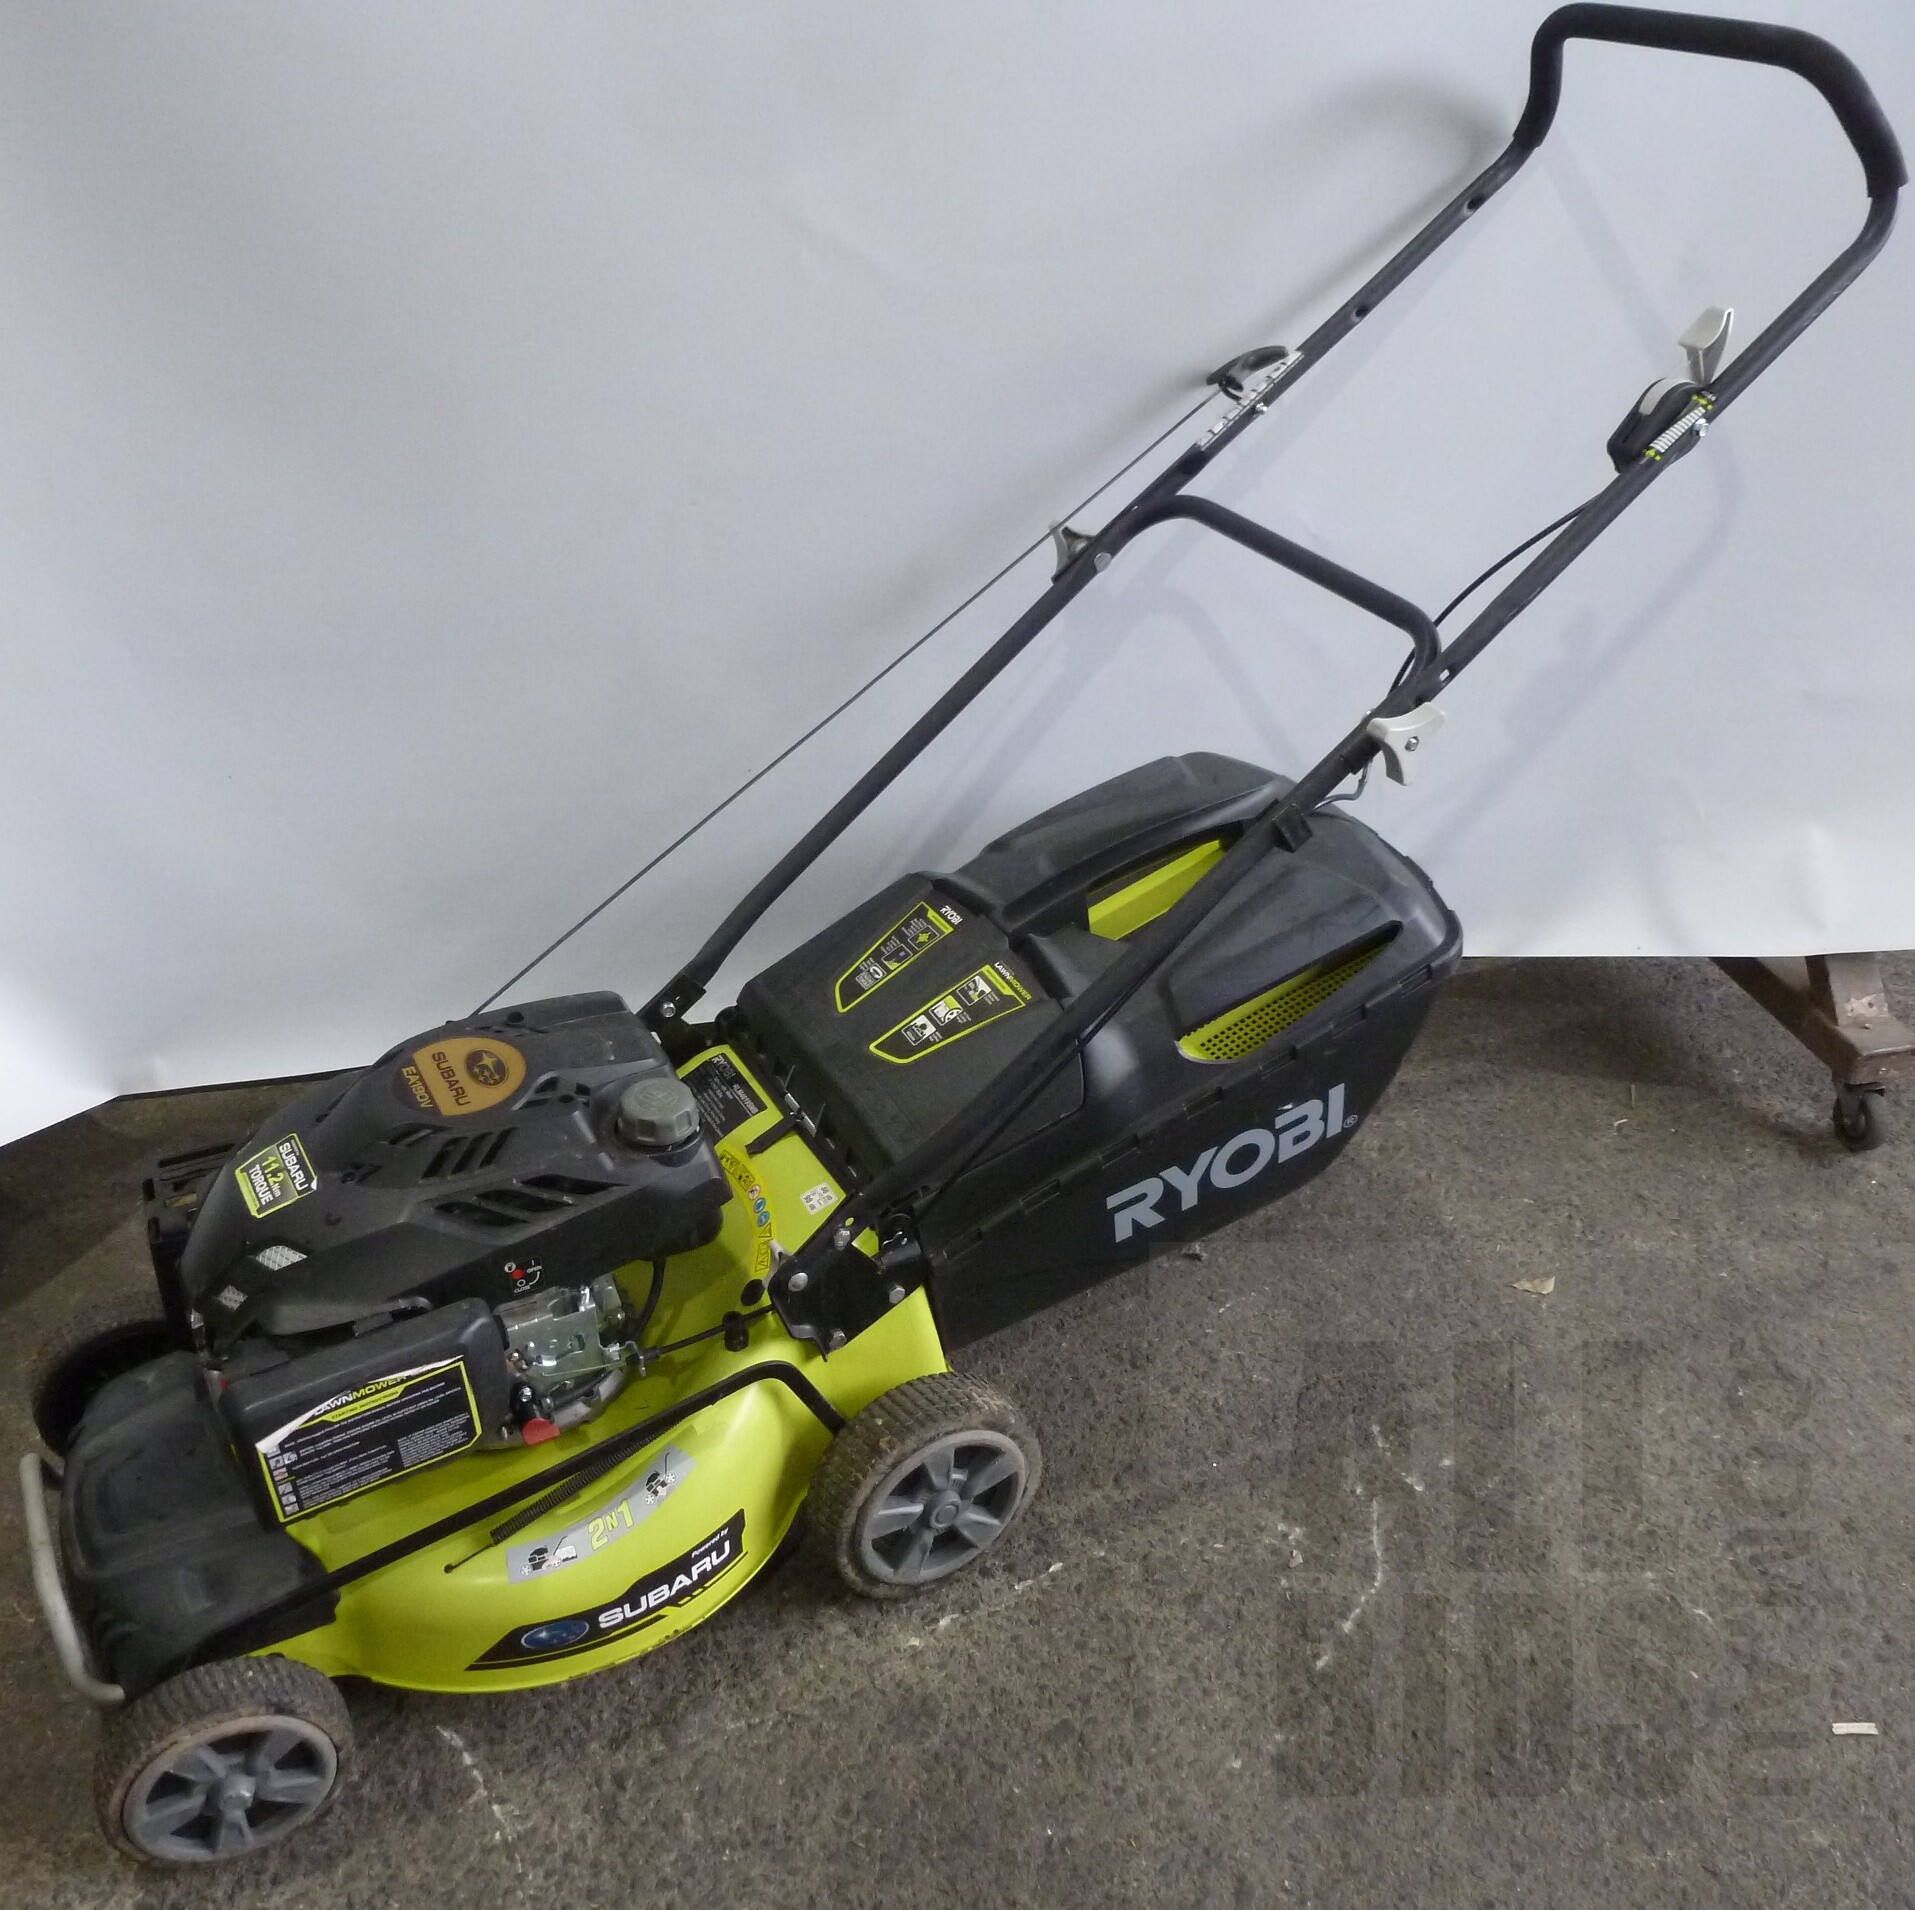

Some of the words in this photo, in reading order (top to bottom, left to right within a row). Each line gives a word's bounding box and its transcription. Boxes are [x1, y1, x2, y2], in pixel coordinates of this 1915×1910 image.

[940, 905, 963, 925] RYOBI
[402, 1066, 434, 1109] EA190V
[431, 1051, 471, 1106] SUBARU
[249, 1164, 274, 1205] TORQUE
[279, 1142, 309, 1191] SUBARU
[1106, 1082, 1346, 1243] RYOBI
[598, 1540, 731, 1629] SUBARU
